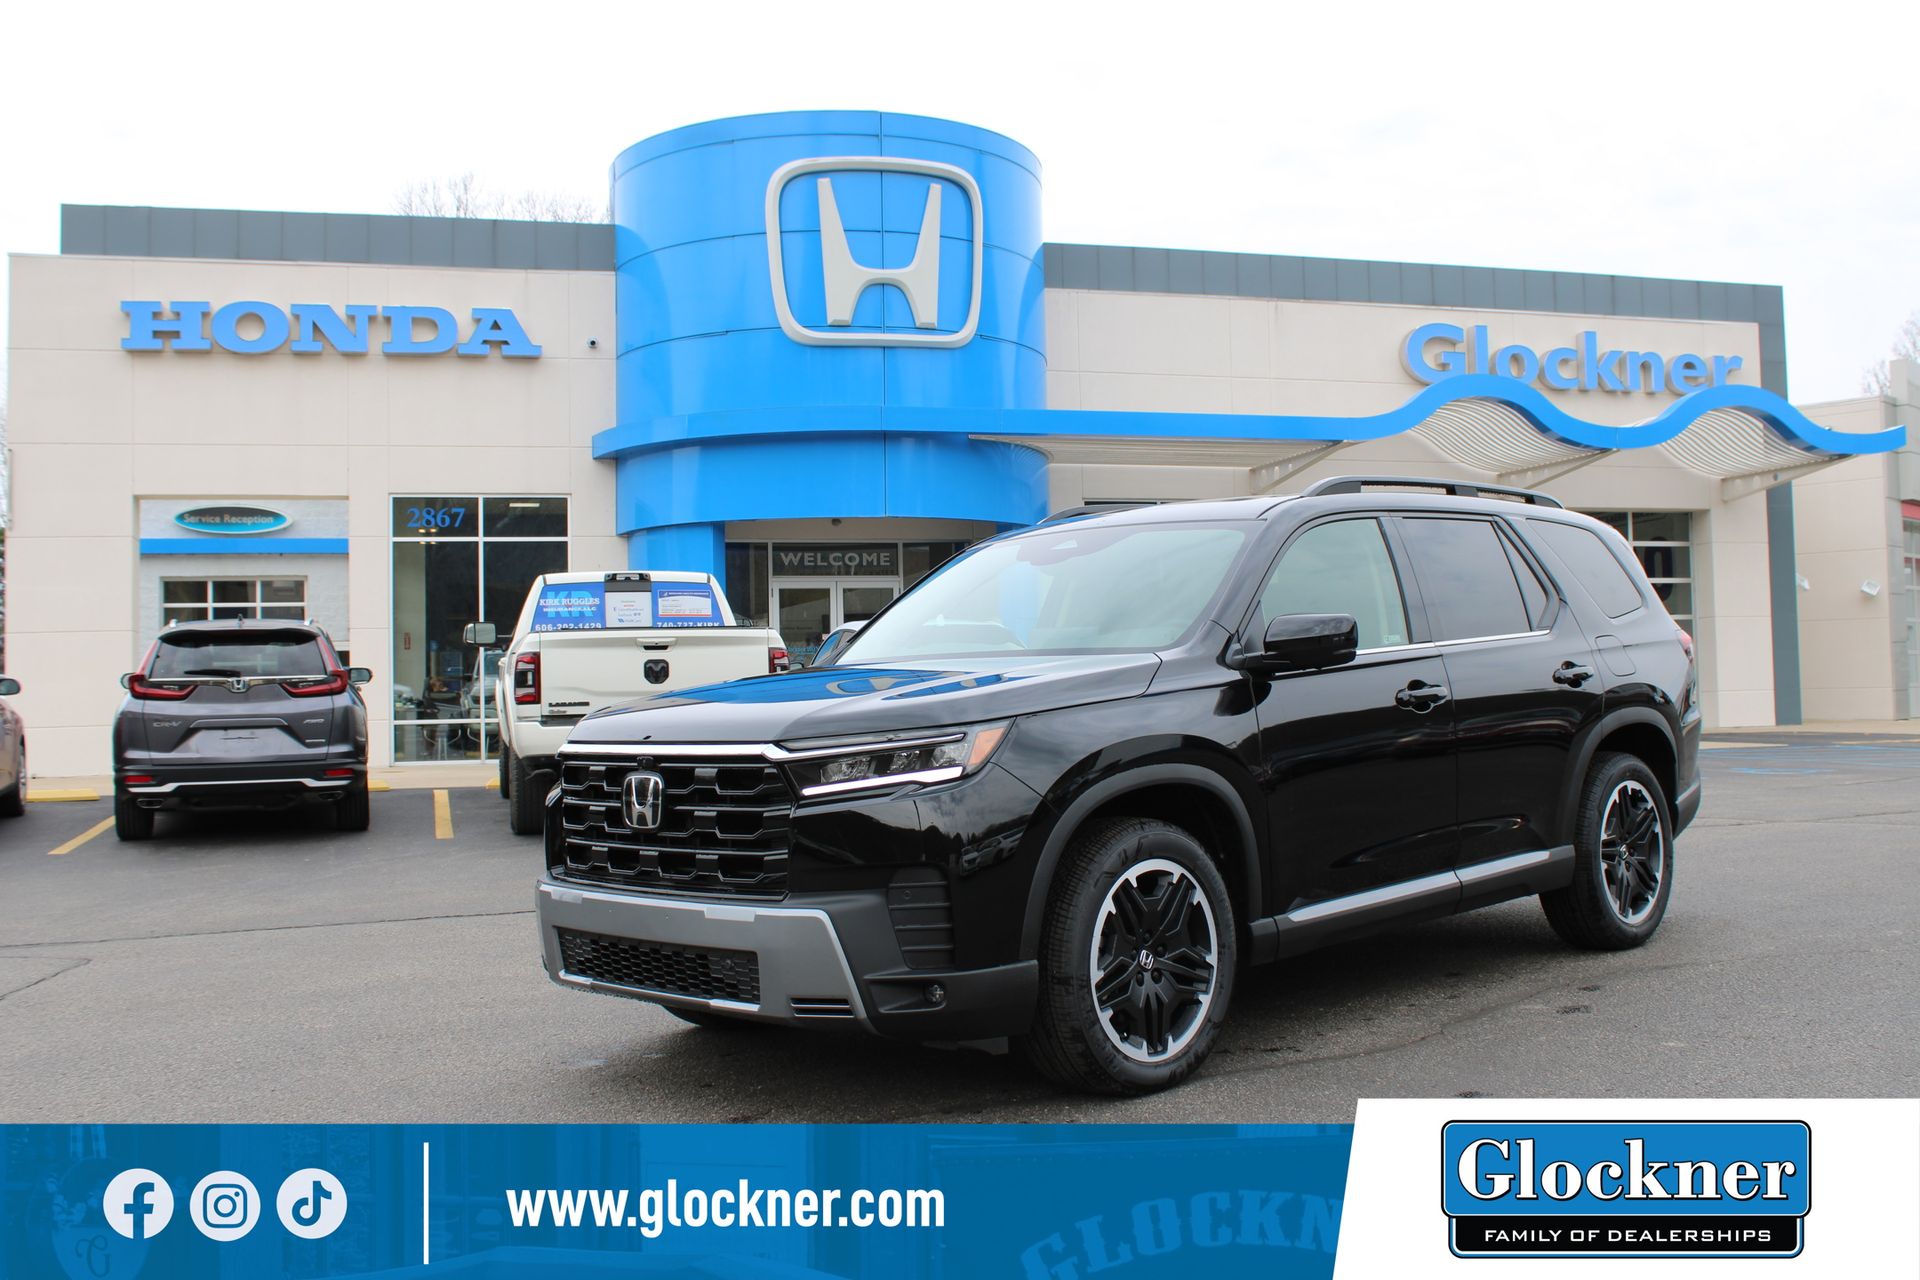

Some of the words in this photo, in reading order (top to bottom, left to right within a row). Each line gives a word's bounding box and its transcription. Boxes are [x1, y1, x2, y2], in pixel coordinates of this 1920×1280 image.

[120, 300, 542, 358] HONDA
[1402, 322, 1744, 394] Glockner
[183, 513, 221, 523] Service
[223, 514, 273, 525] Reception
[406, 507, 466, 528] 2867
[780, 552, 891, 566] WELCOME
[539, 598, 560, 606] KIRK
[561, 597, 600, 606] RUGGLES
[546, 590, 594, 618] KR
